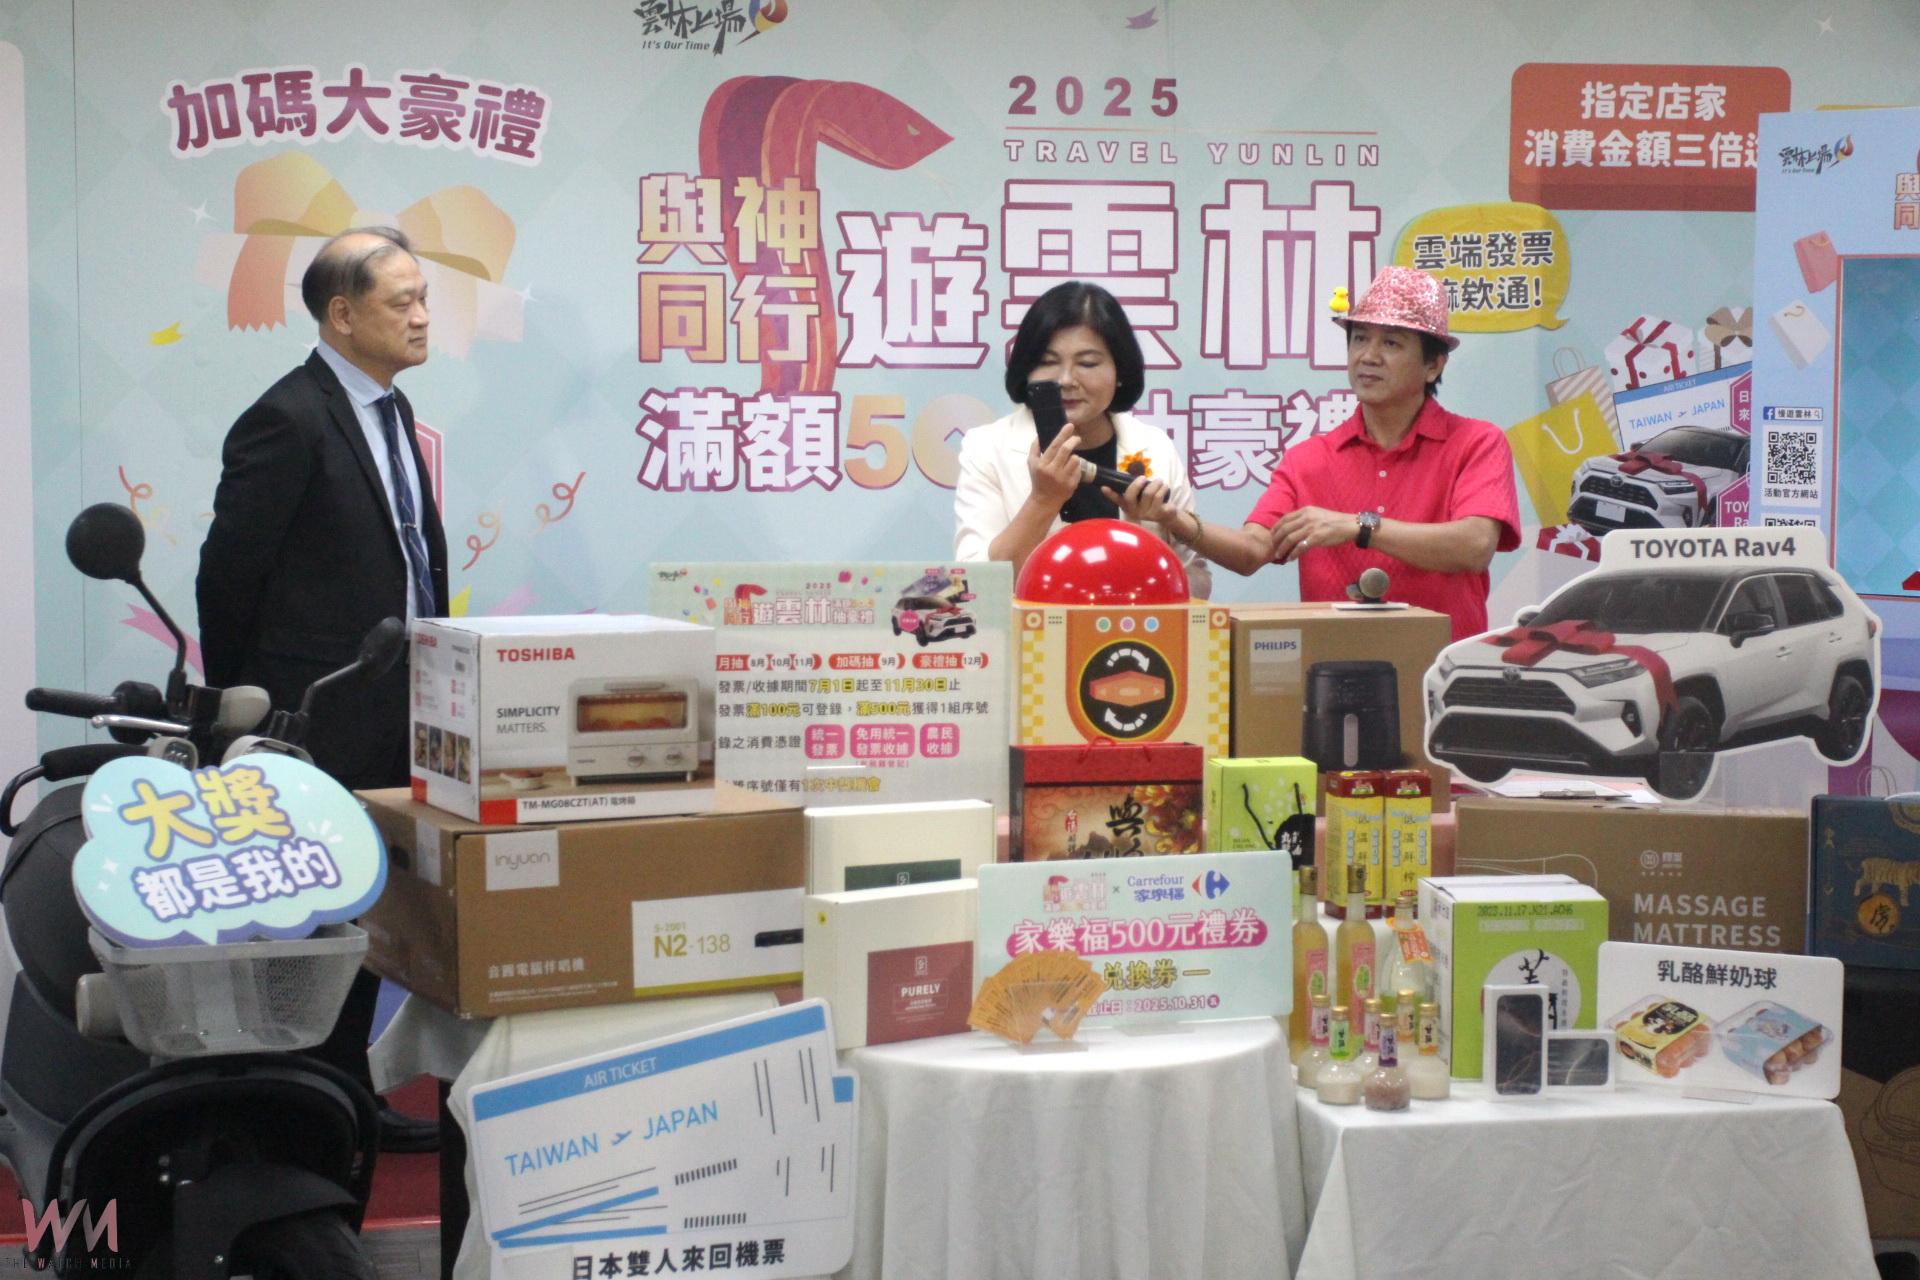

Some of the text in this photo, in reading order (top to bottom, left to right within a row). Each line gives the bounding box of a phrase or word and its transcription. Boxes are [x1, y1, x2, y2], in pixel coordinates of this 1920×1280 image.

[633, 0, 747, 56] 雲林上場
[642, 40, 710, 50] It's Our Time
[1007, 75, 1179, 117] 2025
[1580, 81, 1728, 121] 指定店家
[166, 66, 546, 158] 加碼大豪禮
[1003, 139, 1380, 167] TRAVEL YUNLIN
[638, 172, 820, 264] 與神
[1414, 230, 1554, 269] 雲端發票
[836, 178, 1382, 370] 遊雲林
[637, 271, 820, 363] 同行
[1629, 399, 1726, 430] TAIWAN JAPAN
[1764, 488, 1819, 499] 活動官方網站
[1630, 536, 1797, 559] TOYOTA Rav4
[496, 647, 576, 663] TOSHIBA
[1254, 640, 1297, 650] PHILIPS
[836, 655, 874, 668] 加碼抽
[496, 705, 560, 719] SIMPLICITY
[812, 727, 838, 741] 統一
[856, 726, 909, 741] 免用統一
[812, 743, 838, 756] 發票
[120, 765, 294, 859] 大獎
[133, 841, 340, 920] 都是我的
[1127, 874, 1185, 888] Carrefour
[1134, 887, 1185, 903] 家樂福
[1633, 893, 1767, 918] MASSAGE
[1013, 908, 1261, 955] 家樂福500元禮券
[1633, 922, 1782, 946] MATTRESS
[1103, 959, 1178, 991] 兌換券
[1657, 960, 1778, 989] 乳酪鮮奶球
[901, 983, 941, 997] PURELY
[584, 1057, 657, 1089] AIR TICKET
[505, 1101, 718, 1177] TAIWAN JAPAN
[572, 1238, 786, 1280] 日本雙人來回機票
